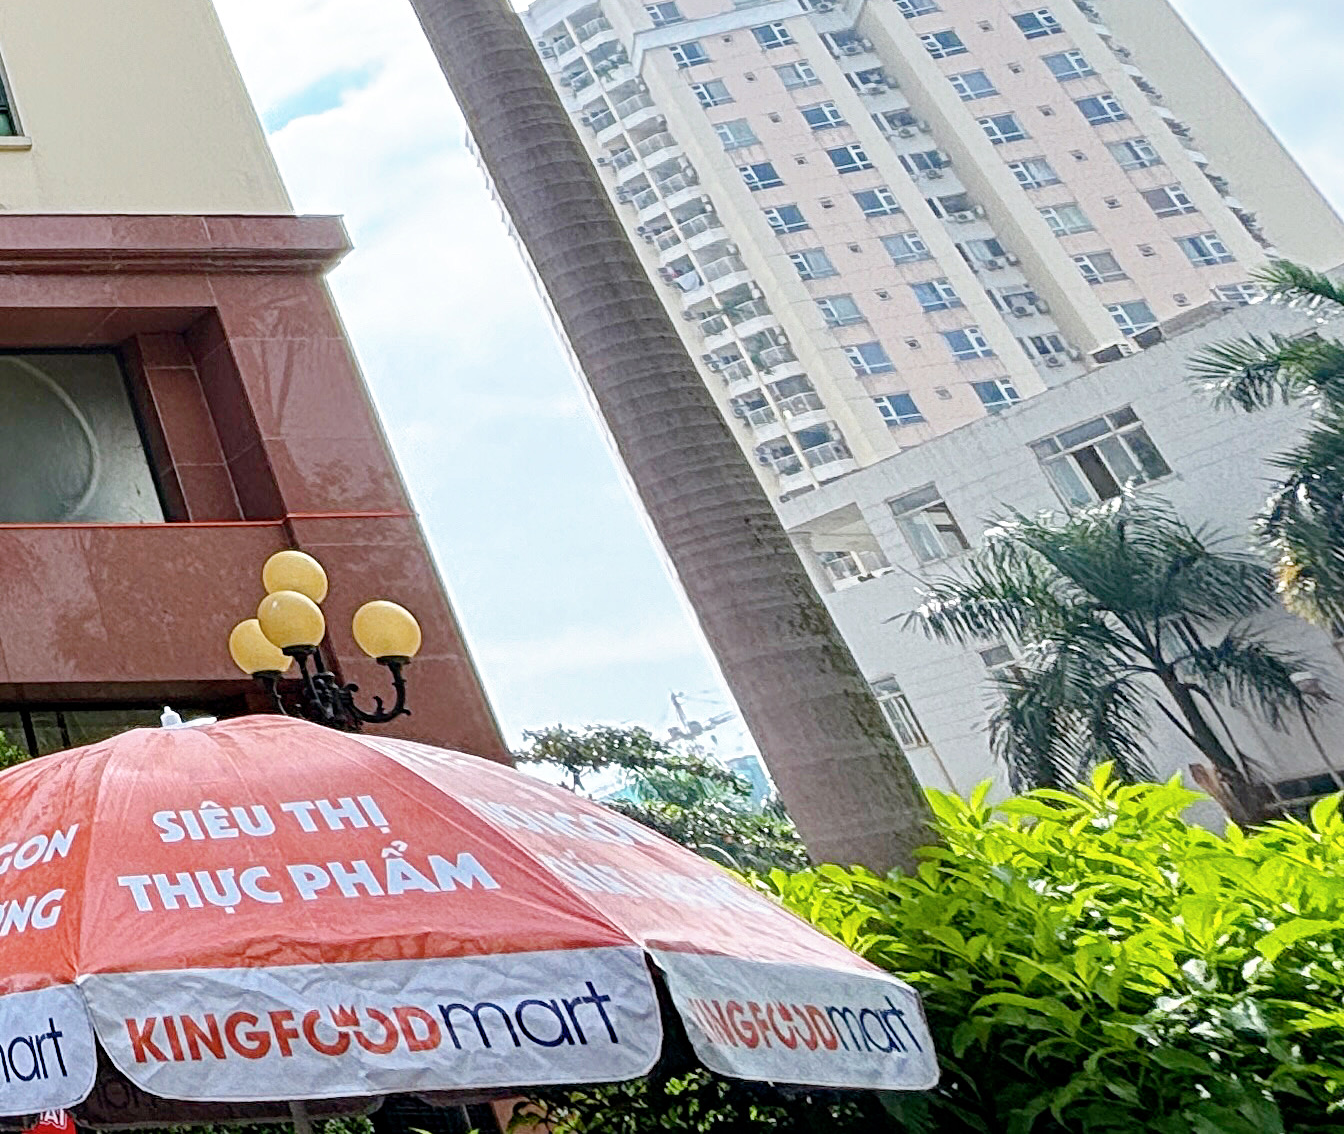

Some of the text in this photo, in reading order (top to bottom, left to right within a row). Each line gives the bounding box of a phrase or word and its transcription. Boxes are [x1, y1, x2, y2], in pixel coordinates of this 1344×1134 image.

[153, 795, 391, 843] SIÊU THỊ
[117, 839, 501, 914] THỰC PHẨM
